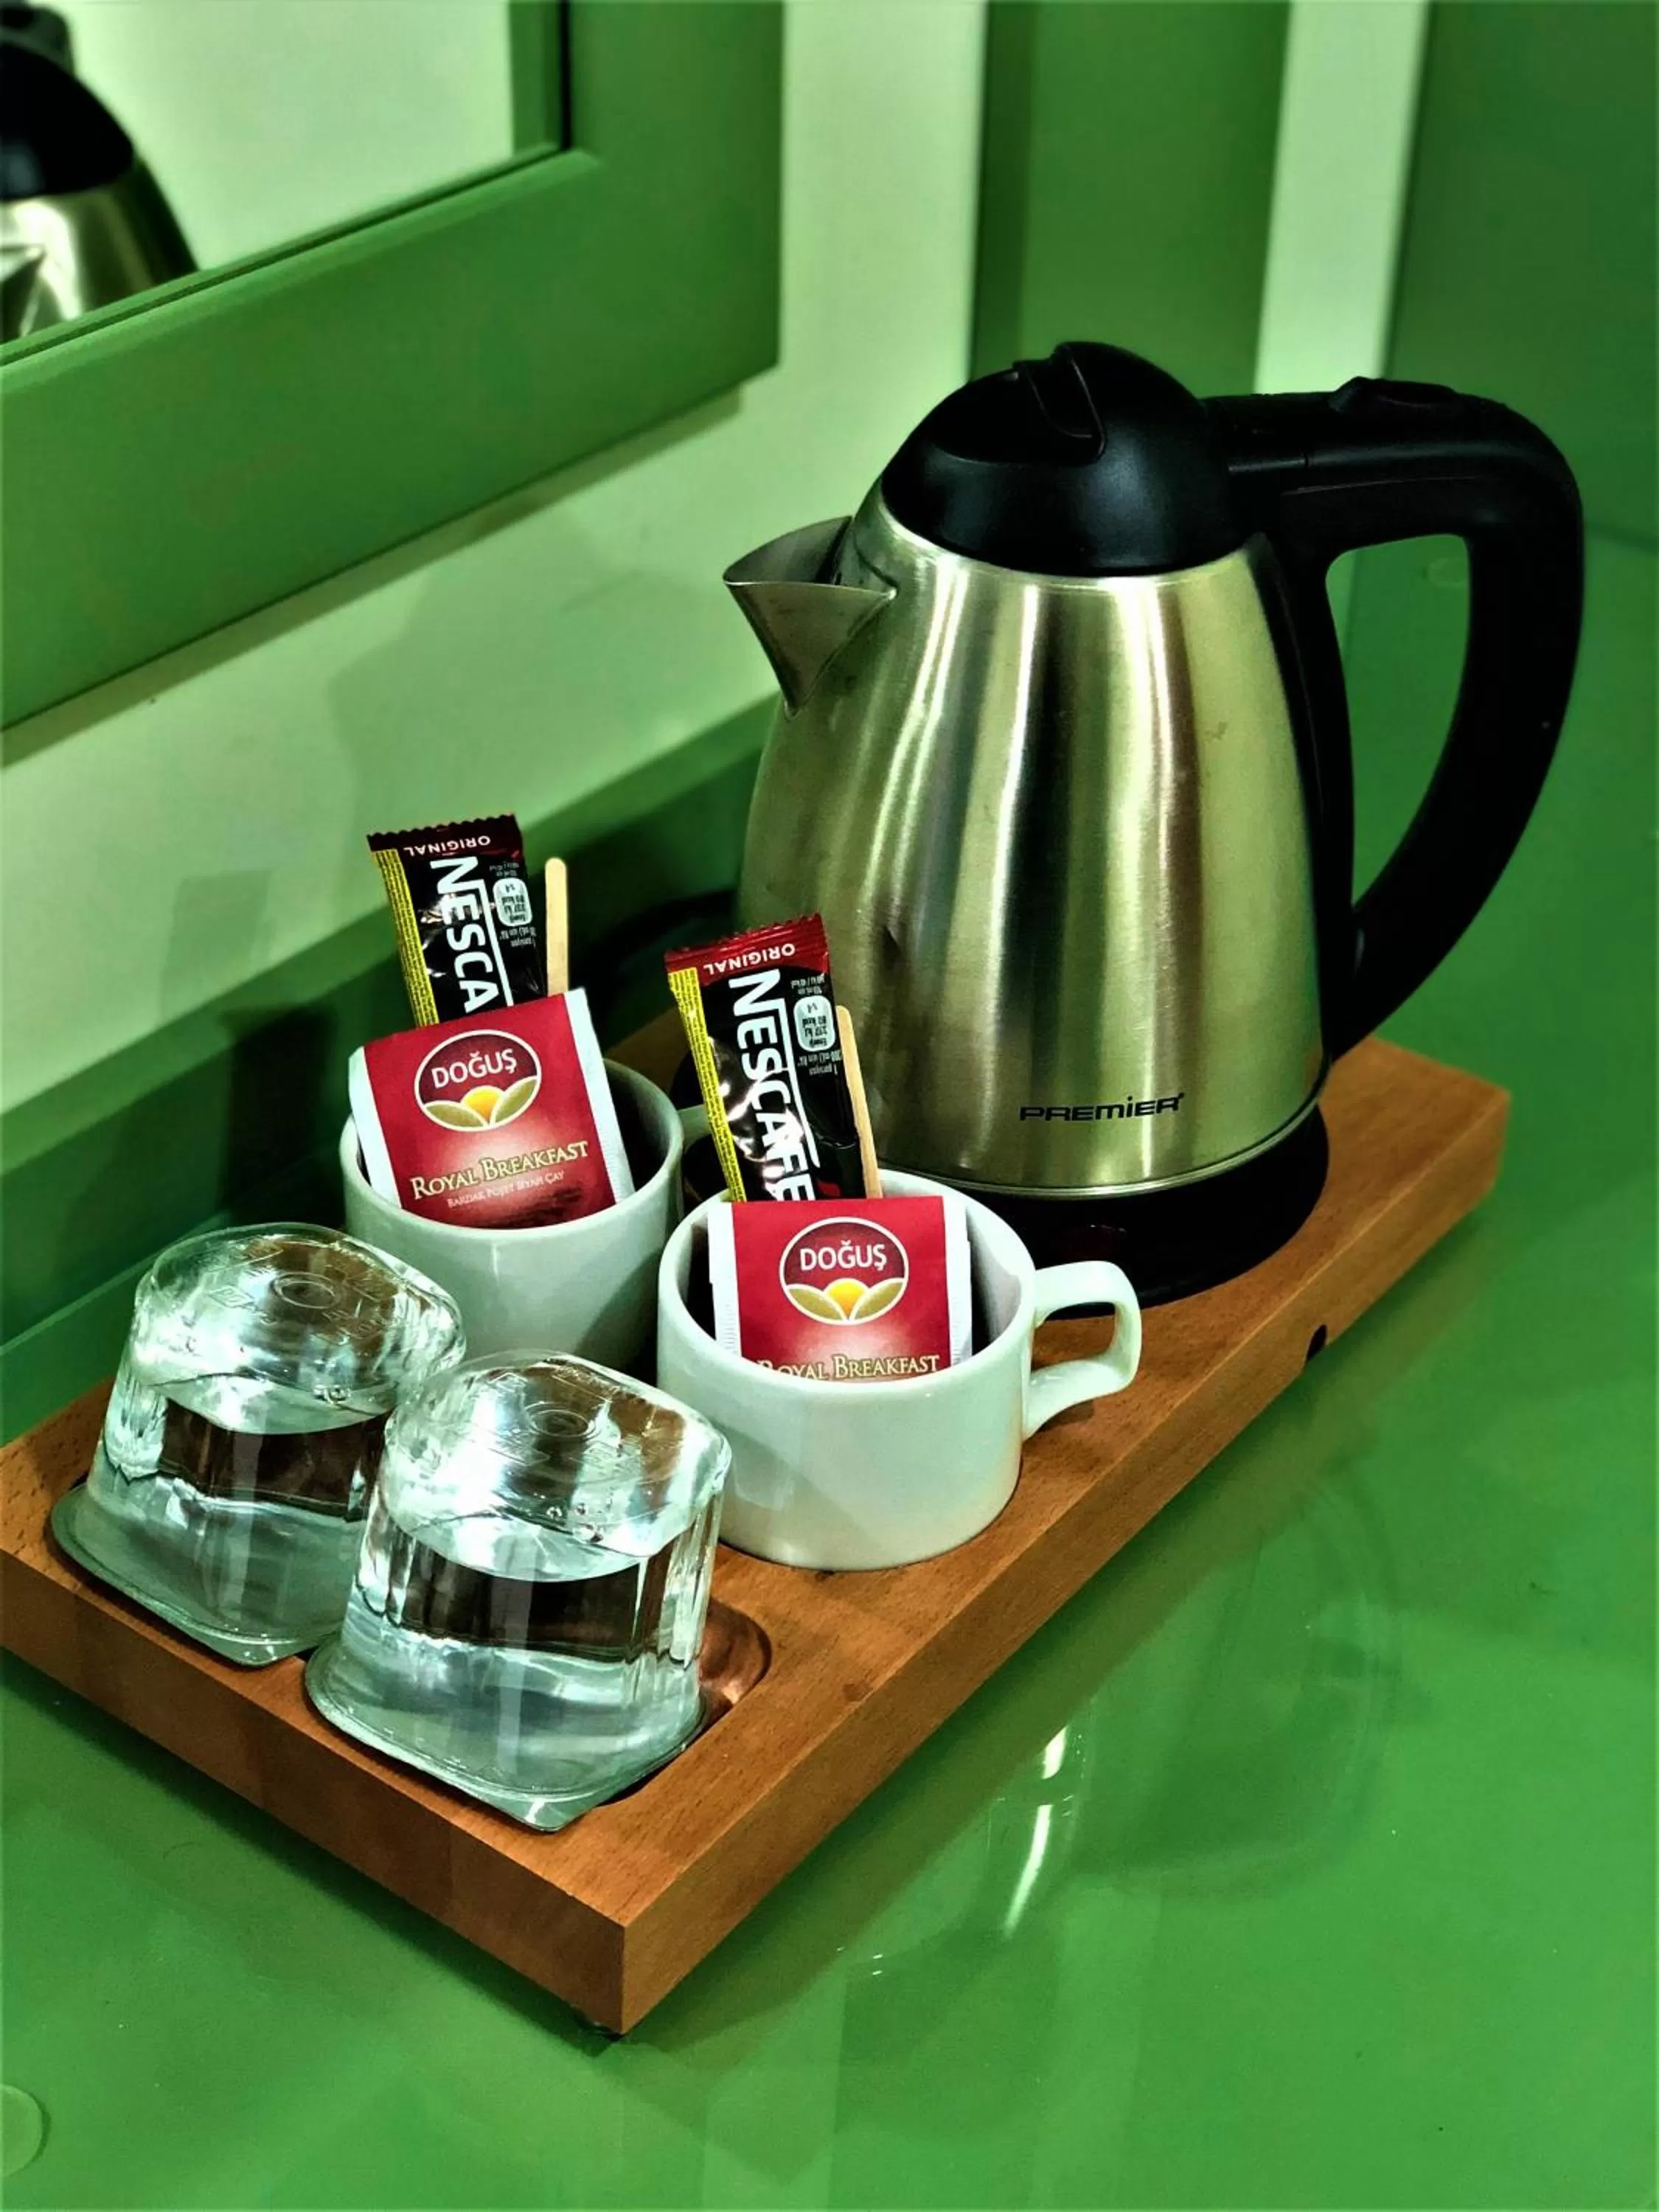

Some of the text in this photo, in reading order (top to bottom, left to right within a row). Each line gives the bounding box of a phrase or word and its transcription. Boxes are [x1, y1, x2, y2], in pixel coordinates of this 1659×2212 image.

[403, 835, 491, 857] ORIGINAL
[429, 856, 514, 1014] NESCA
[703, 943, 796, 975] ORIGINAL
[431, 1048, 517, 1088] DOĞUŞ
[410, 1141, 588, 1200] ROYAL BREAKFAST
[800, 1240, 887, 1271] DOĞUŞ
[833, 1354, 940, 1379] BREAKFAST
